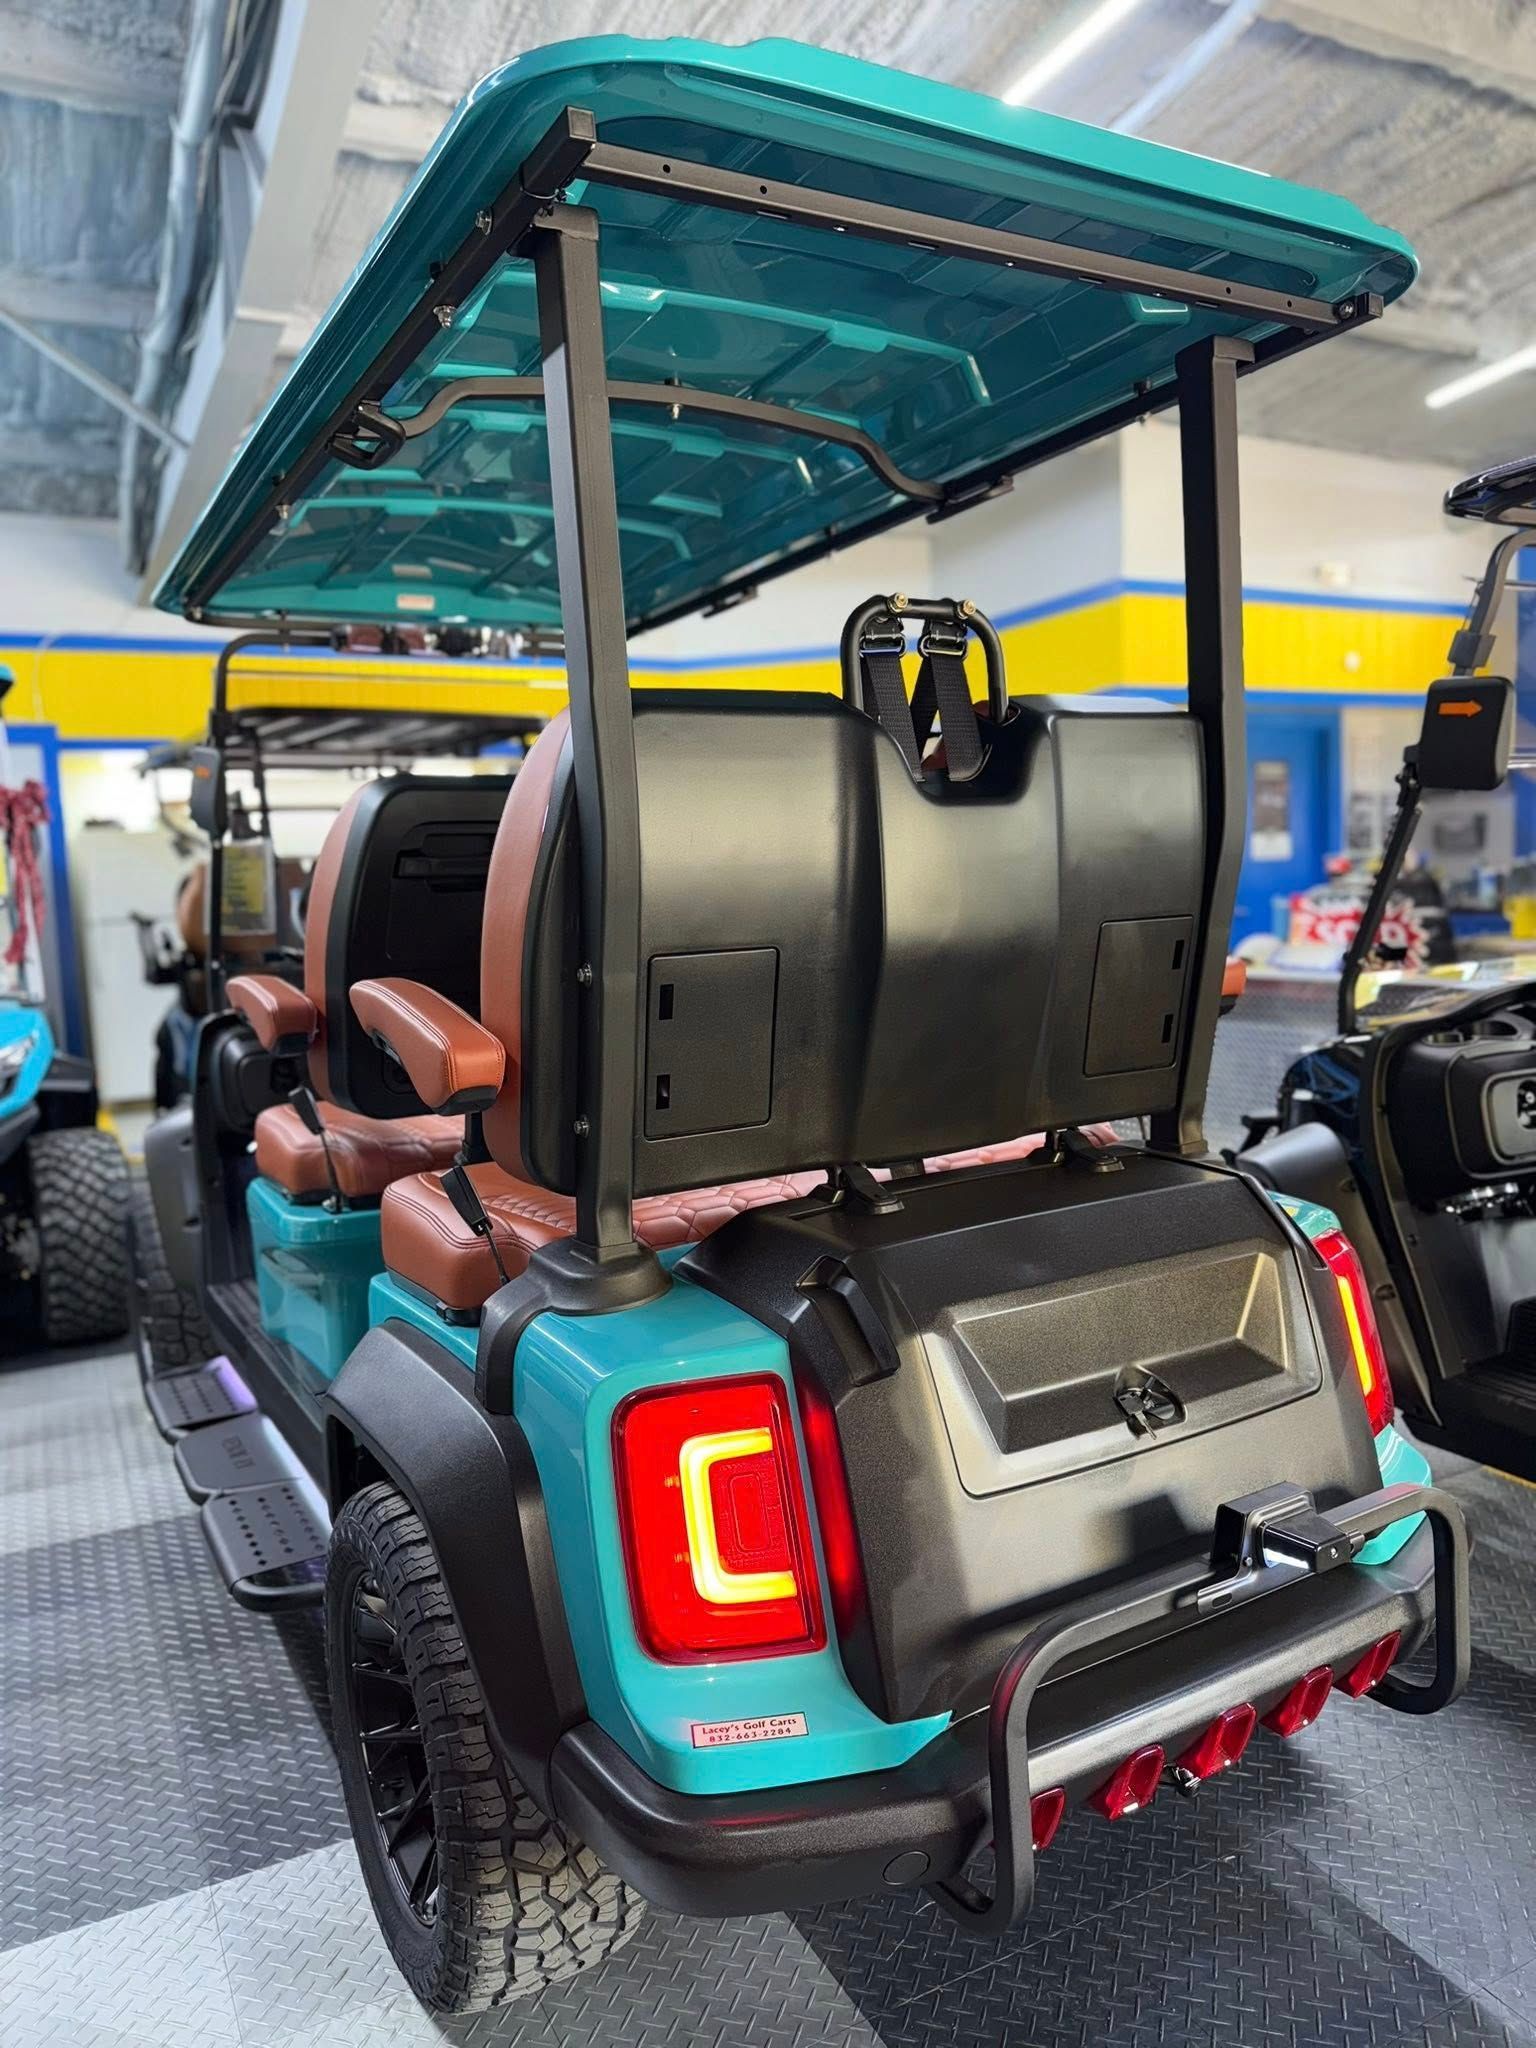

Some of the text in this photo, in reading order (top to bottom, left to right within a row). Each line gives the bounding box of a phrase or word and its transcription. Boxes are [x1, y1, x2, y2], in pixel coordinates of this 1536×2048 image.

[702, 1717, 797, 1735] Lacey's Golf Carts
[709, 1727, 792, 1743] 832-663-2284
